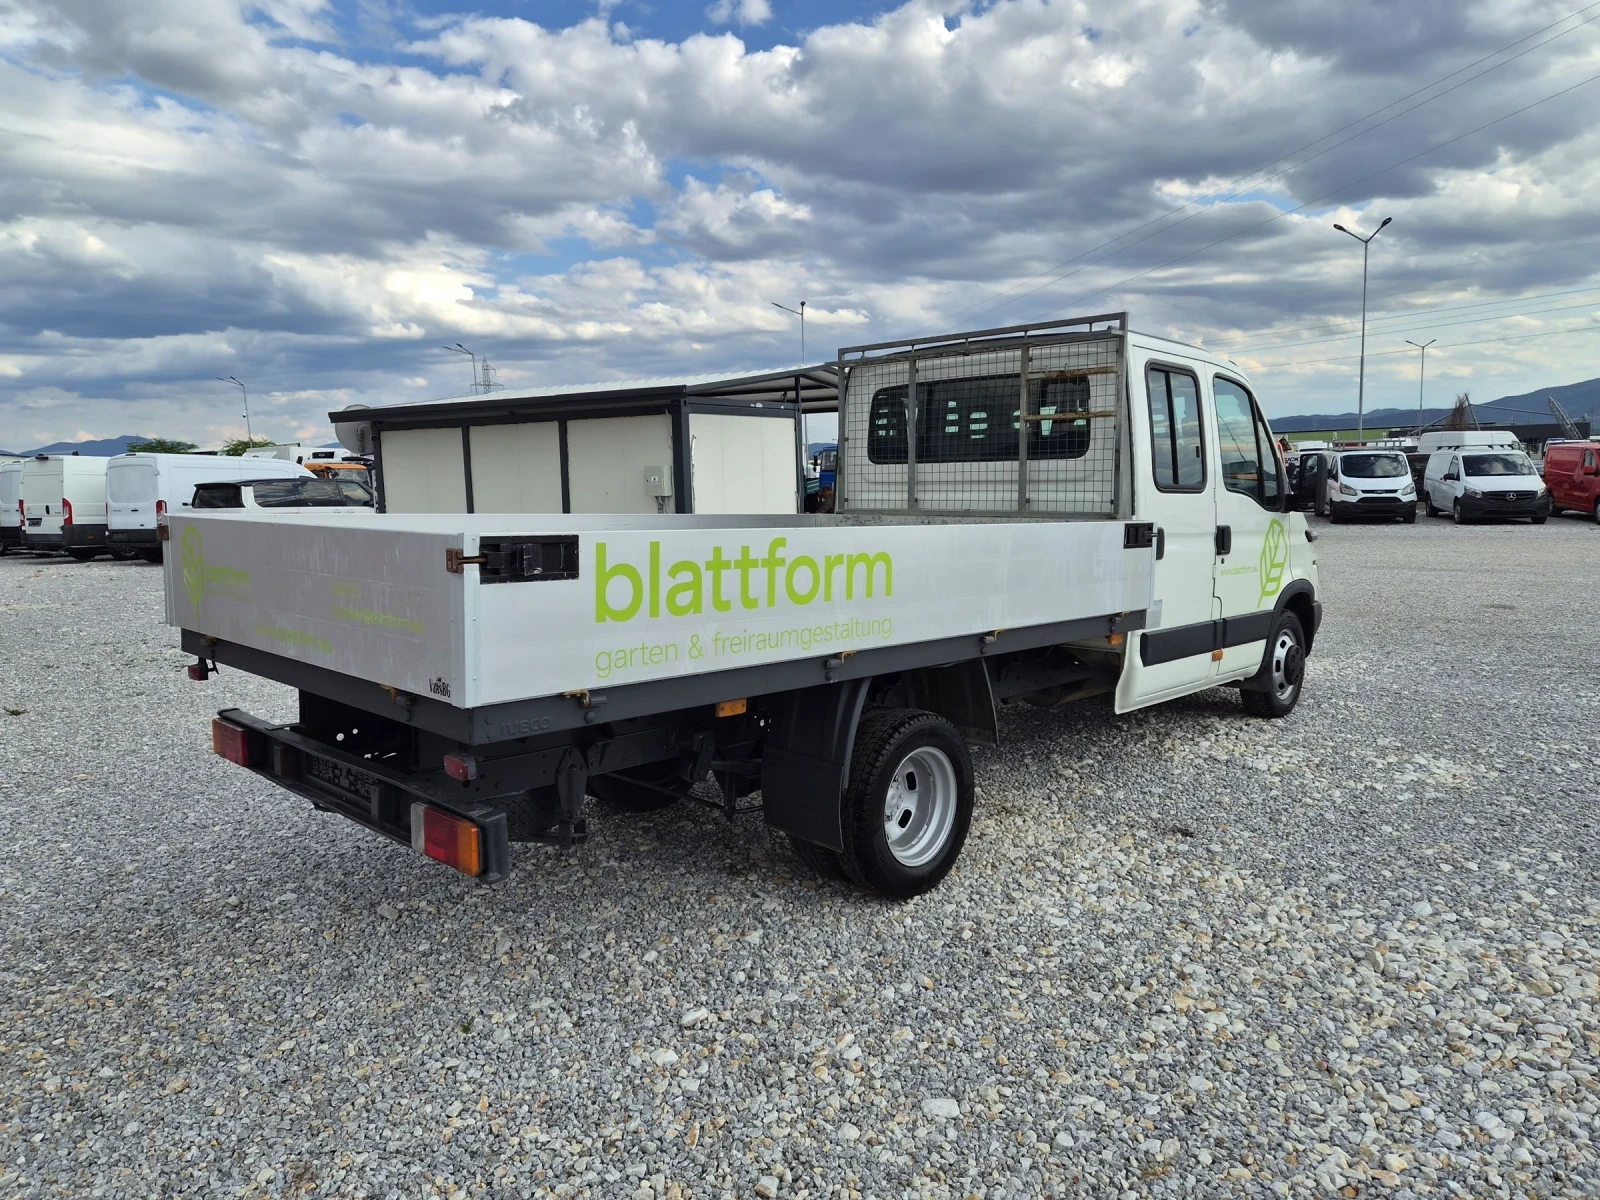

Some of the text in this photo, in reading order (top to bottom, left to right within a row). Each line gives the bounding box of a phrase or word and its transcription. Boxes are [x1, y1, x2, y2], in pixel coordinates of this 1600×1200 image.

[595, 537, 893, 624] blattform
[595, 615, 893, 680] garten & freiraumgestaltung
